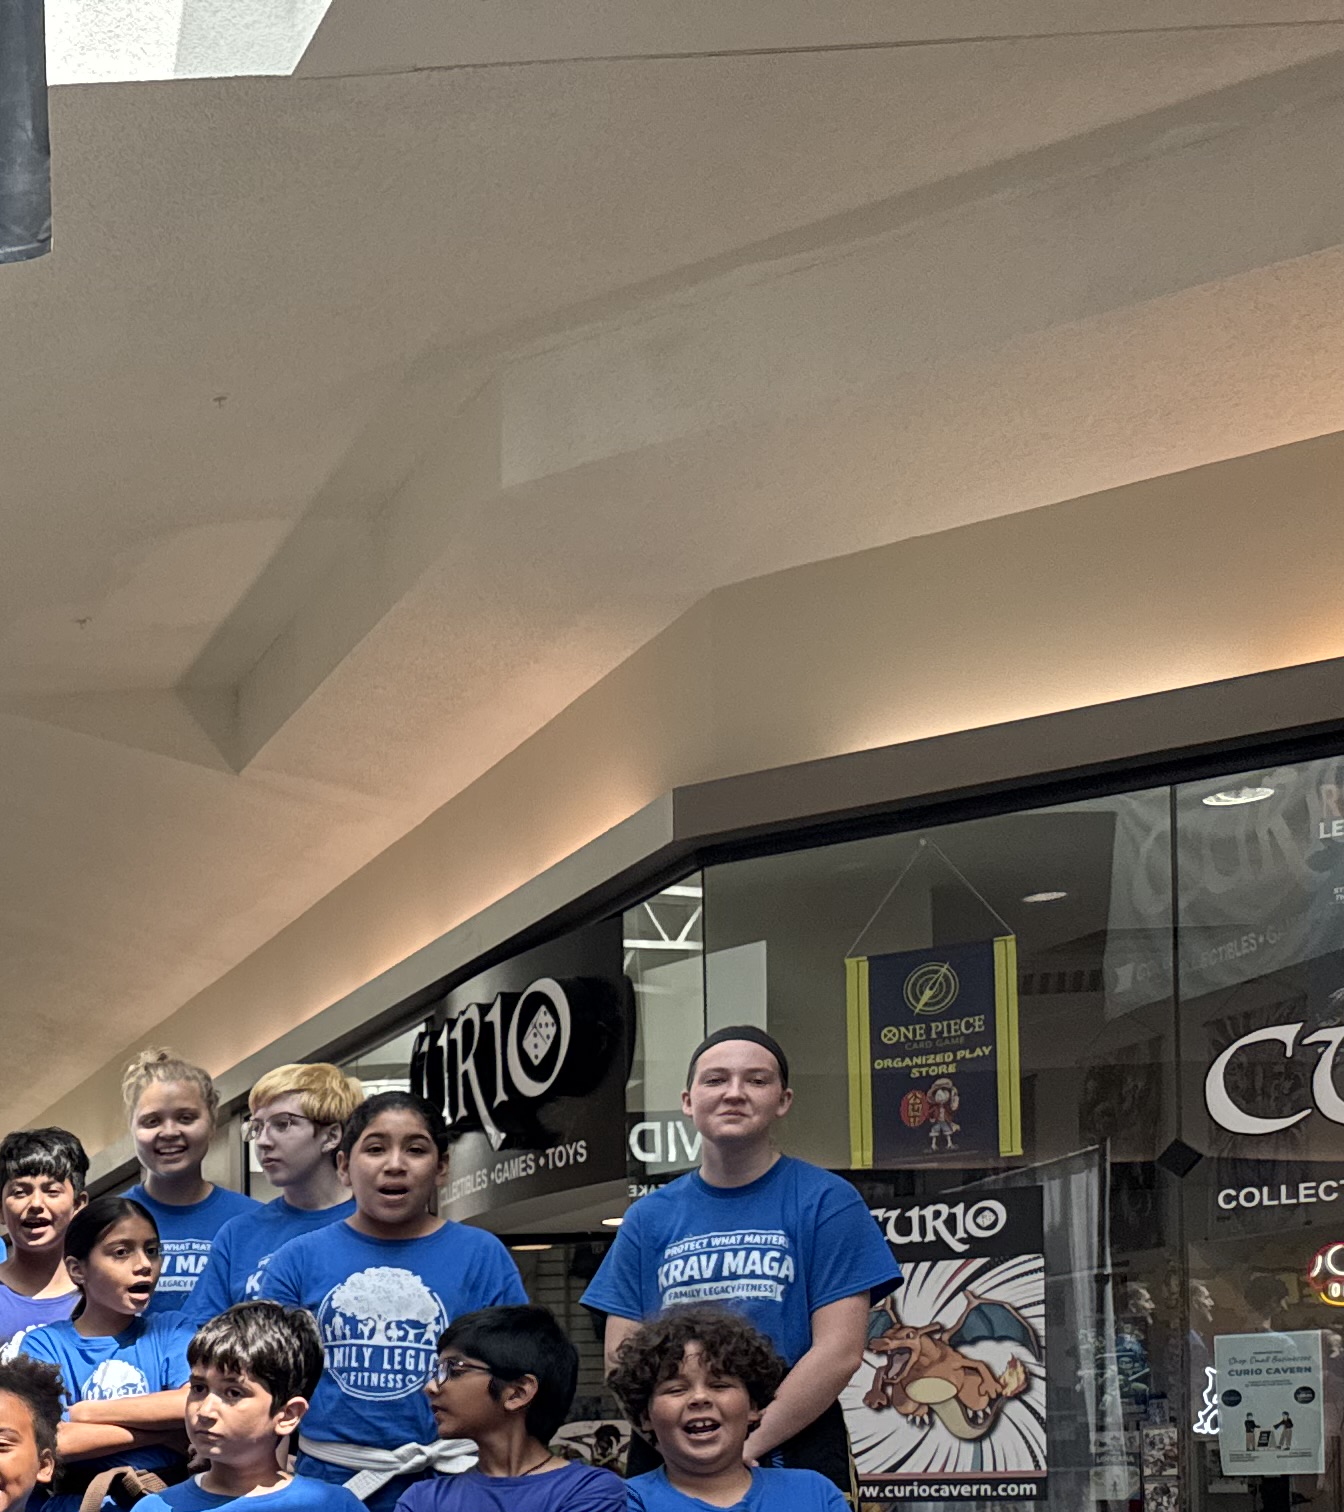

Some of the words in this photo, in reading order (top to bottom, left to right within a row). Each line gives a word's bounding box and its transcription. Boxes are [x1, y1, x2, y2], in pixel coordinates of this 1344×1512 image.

[880, 1022, 926, 1045] ONE
[930, 1014, 986, 1037] PIECE
[904, 1040, 933, 1051] CARD
[935, 1036, 965, 1047] GAME
[874, 1051, 954, 1070] ORGANIZED
[956, 1045, 993, 1061] PLAY
[909, 1063, 957, 1079] STORE
[494, 1153, 535, 1184] GAMES
[546, 1140, 587, 1170] TOYS
[163, 1242, 191, 1251] WHAT
[664, 1238, 709, 1259] PROTECT
[711, 1234, 743, 1247] WHAT
[658, 1253, 718, 1293] KRAV
[722, 1250, 795, 1283] MAGA
[668, 1288, 701, 1301] FAMILY
[703, 1284, 735, 1297] LEGACY
[736, 1283, 774, 1294] FITNESS
[349, 1371, 404, 1388] FITNESS
[1227, 1367, 1263, 1377] CURIO
[1265, 1365, 1312, 1376] CAVERN
[858, 1481, 1037, 1499] w.curiocavern.com
